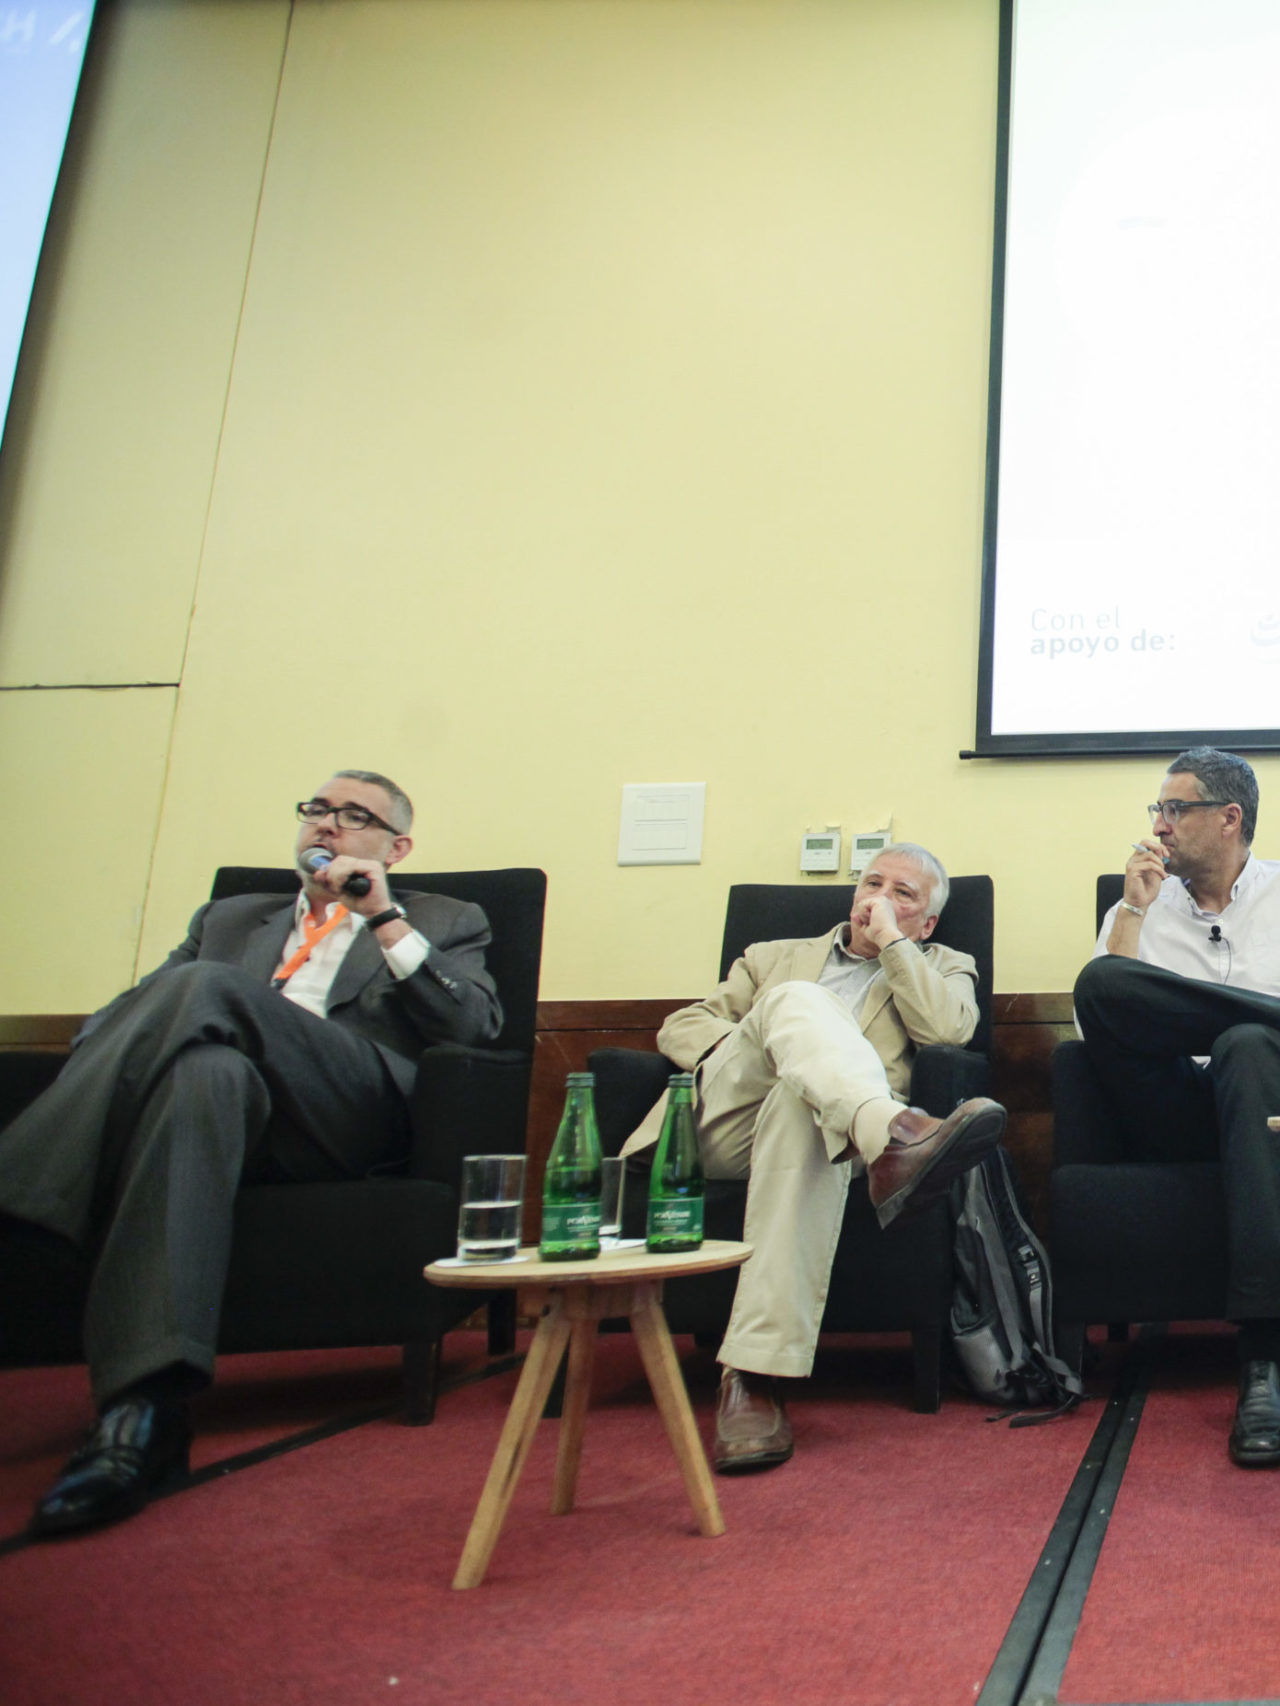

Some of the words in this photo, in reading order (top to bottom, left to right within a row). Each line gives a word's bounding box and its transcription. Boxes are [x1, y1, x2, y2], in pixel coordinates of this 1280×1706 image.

[1031, 607, 1084, 632] Con
[1096, 604, 1121, 629] el
[1030, 634, 1120, 660] apoyo
[1130, 627, 1175, 652] de:
